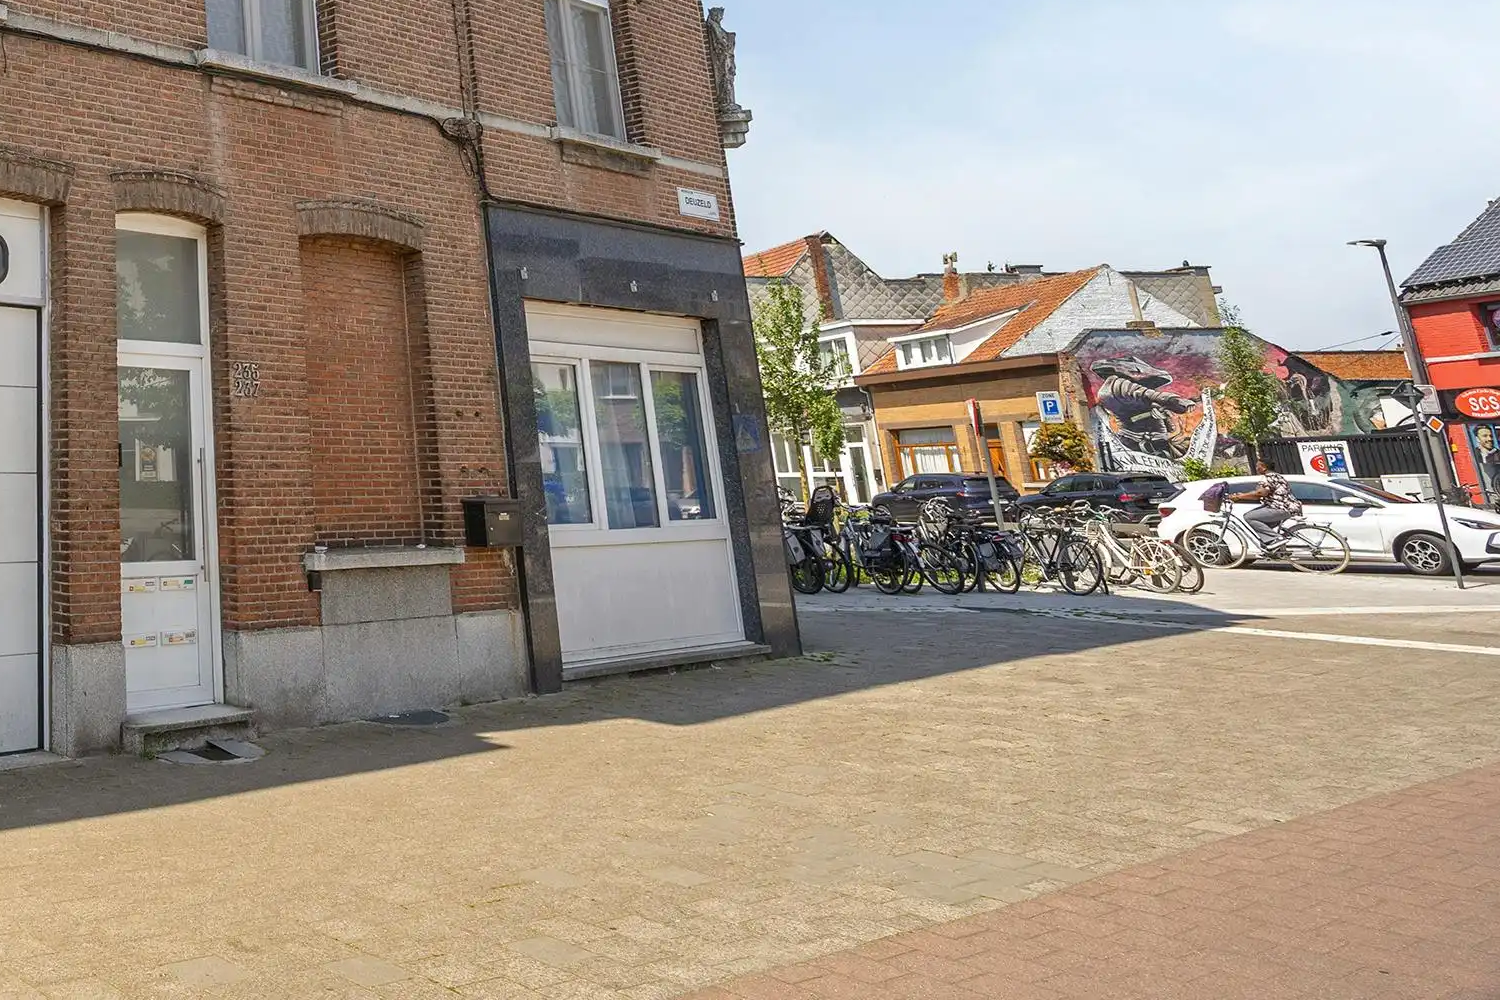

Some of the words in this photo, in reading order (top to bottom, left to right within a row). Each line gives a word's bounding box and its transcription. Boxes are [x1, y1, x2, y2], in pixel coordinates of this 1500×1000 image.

[684, 196, 712, 209] DEUZELD
[232, 361, 260, 380] 235
[1046, 401, 1054, 412] P
[1468, 395, 1500, 411] SCS
[1326, 454, 1337, 467] P
